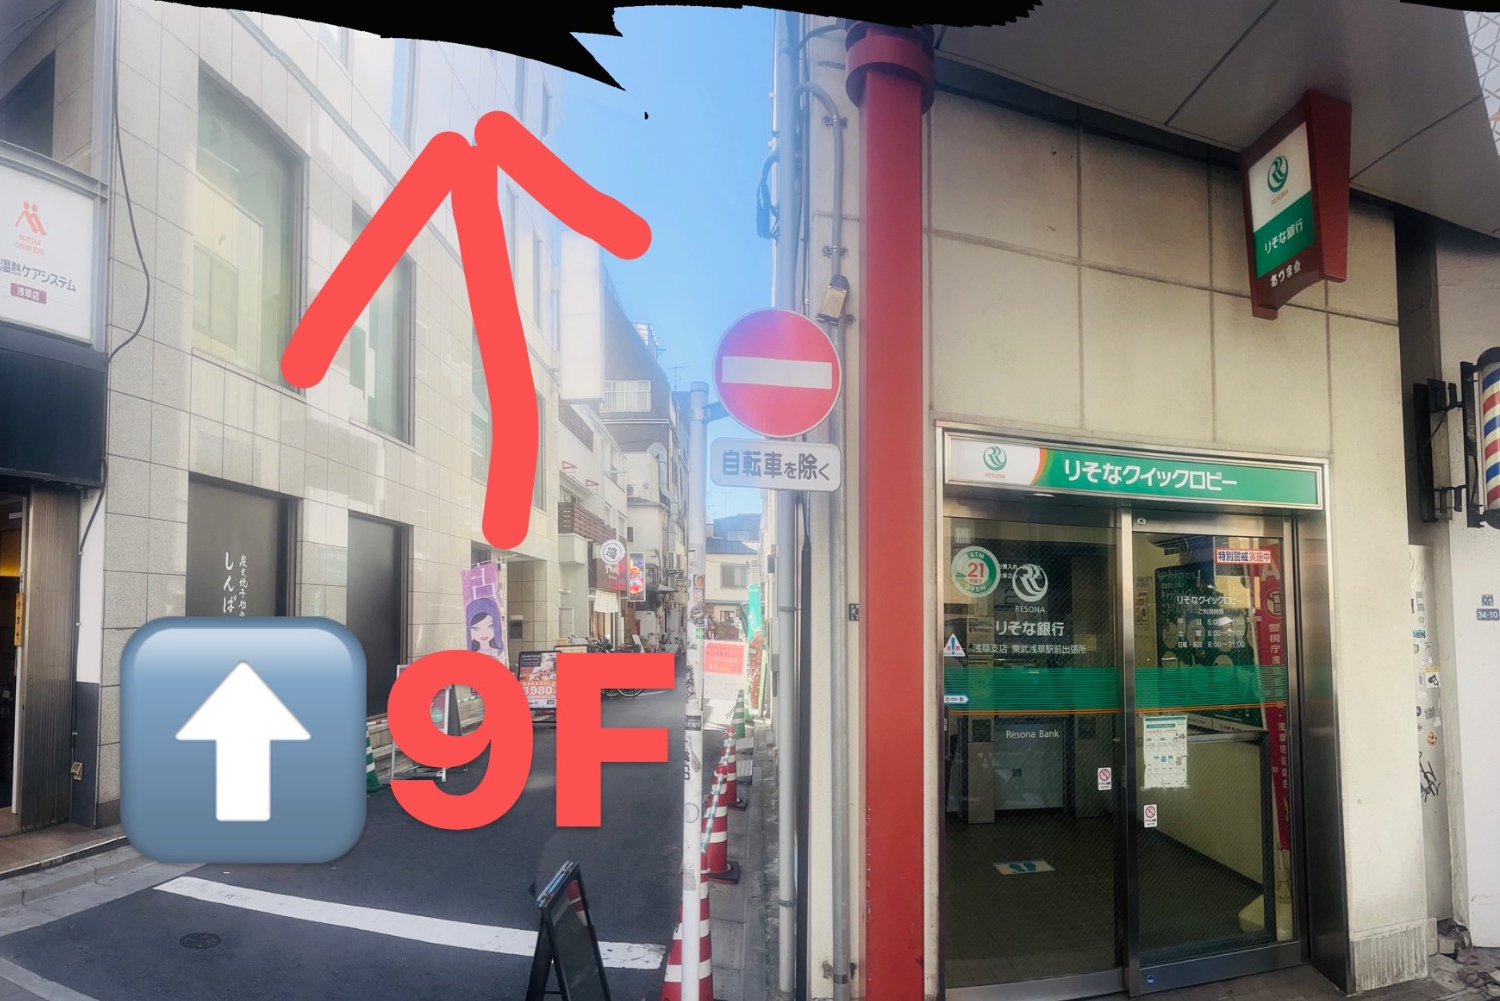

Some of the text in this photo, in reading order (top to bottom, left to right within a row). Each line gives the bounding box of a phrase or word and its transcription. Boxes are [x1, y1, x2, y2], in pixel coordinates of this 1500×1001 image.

[1264, 218, 1304, 255] りそな銀行
[723, 449, 830, 481] 自転車を除く
[1064, 458, 1238, 491] りそなクイックロビー
[969, 551, 985, 560] ATM
[1218, 551, 1272, 563] 特別警戒実施中
[967, 562, 985, 578] 21
[965, 584, 987, 593] OPEN
[1014, 605, 1046, 614] RESONA
[1477, 611, 1499, 619] 34-10
[995, 620, 1065, 637] りそな銀行
[972, 643, 1008, 655] 浅草支店
[1005, 729, 1060, 739] Resona Bank
